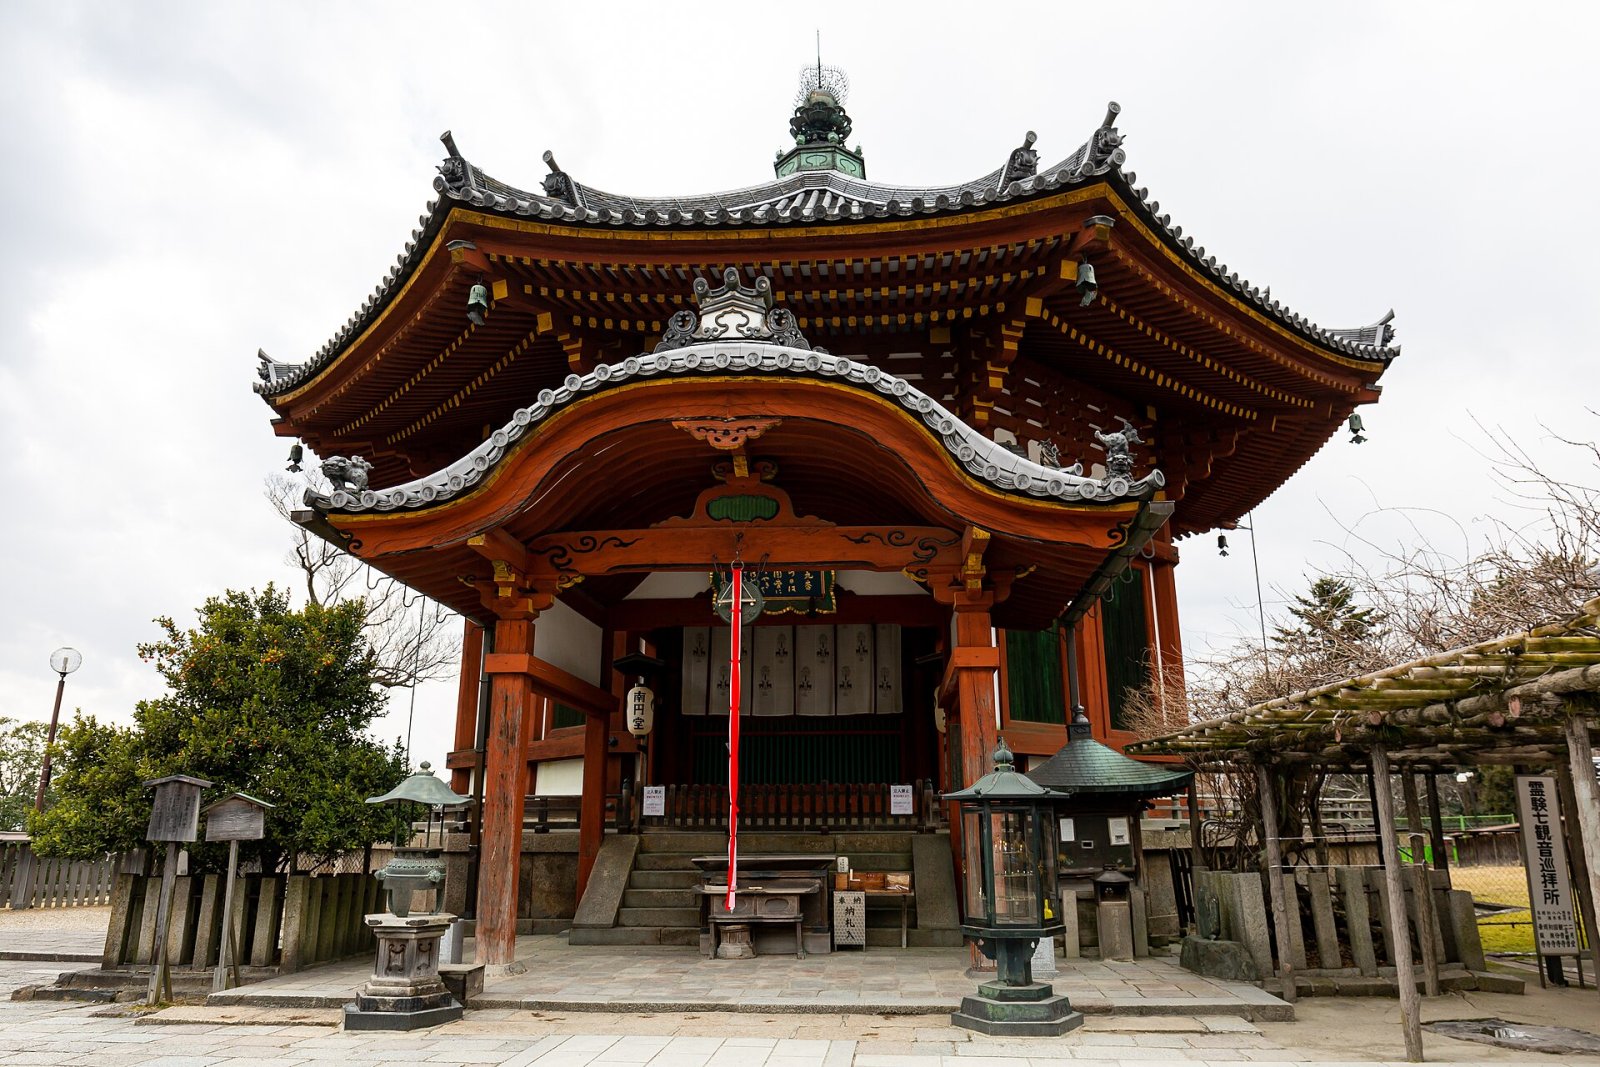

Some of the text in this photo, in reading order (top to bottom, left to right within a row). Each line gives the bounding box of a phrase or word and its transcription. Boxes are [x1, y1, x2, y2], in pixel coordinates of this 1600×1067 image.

[632, 690, 646, 730] 南円堂
[1527, 780, 1560, 906] 霊験七観音巡拝所
[844, 906, 855, 940] 納札入
